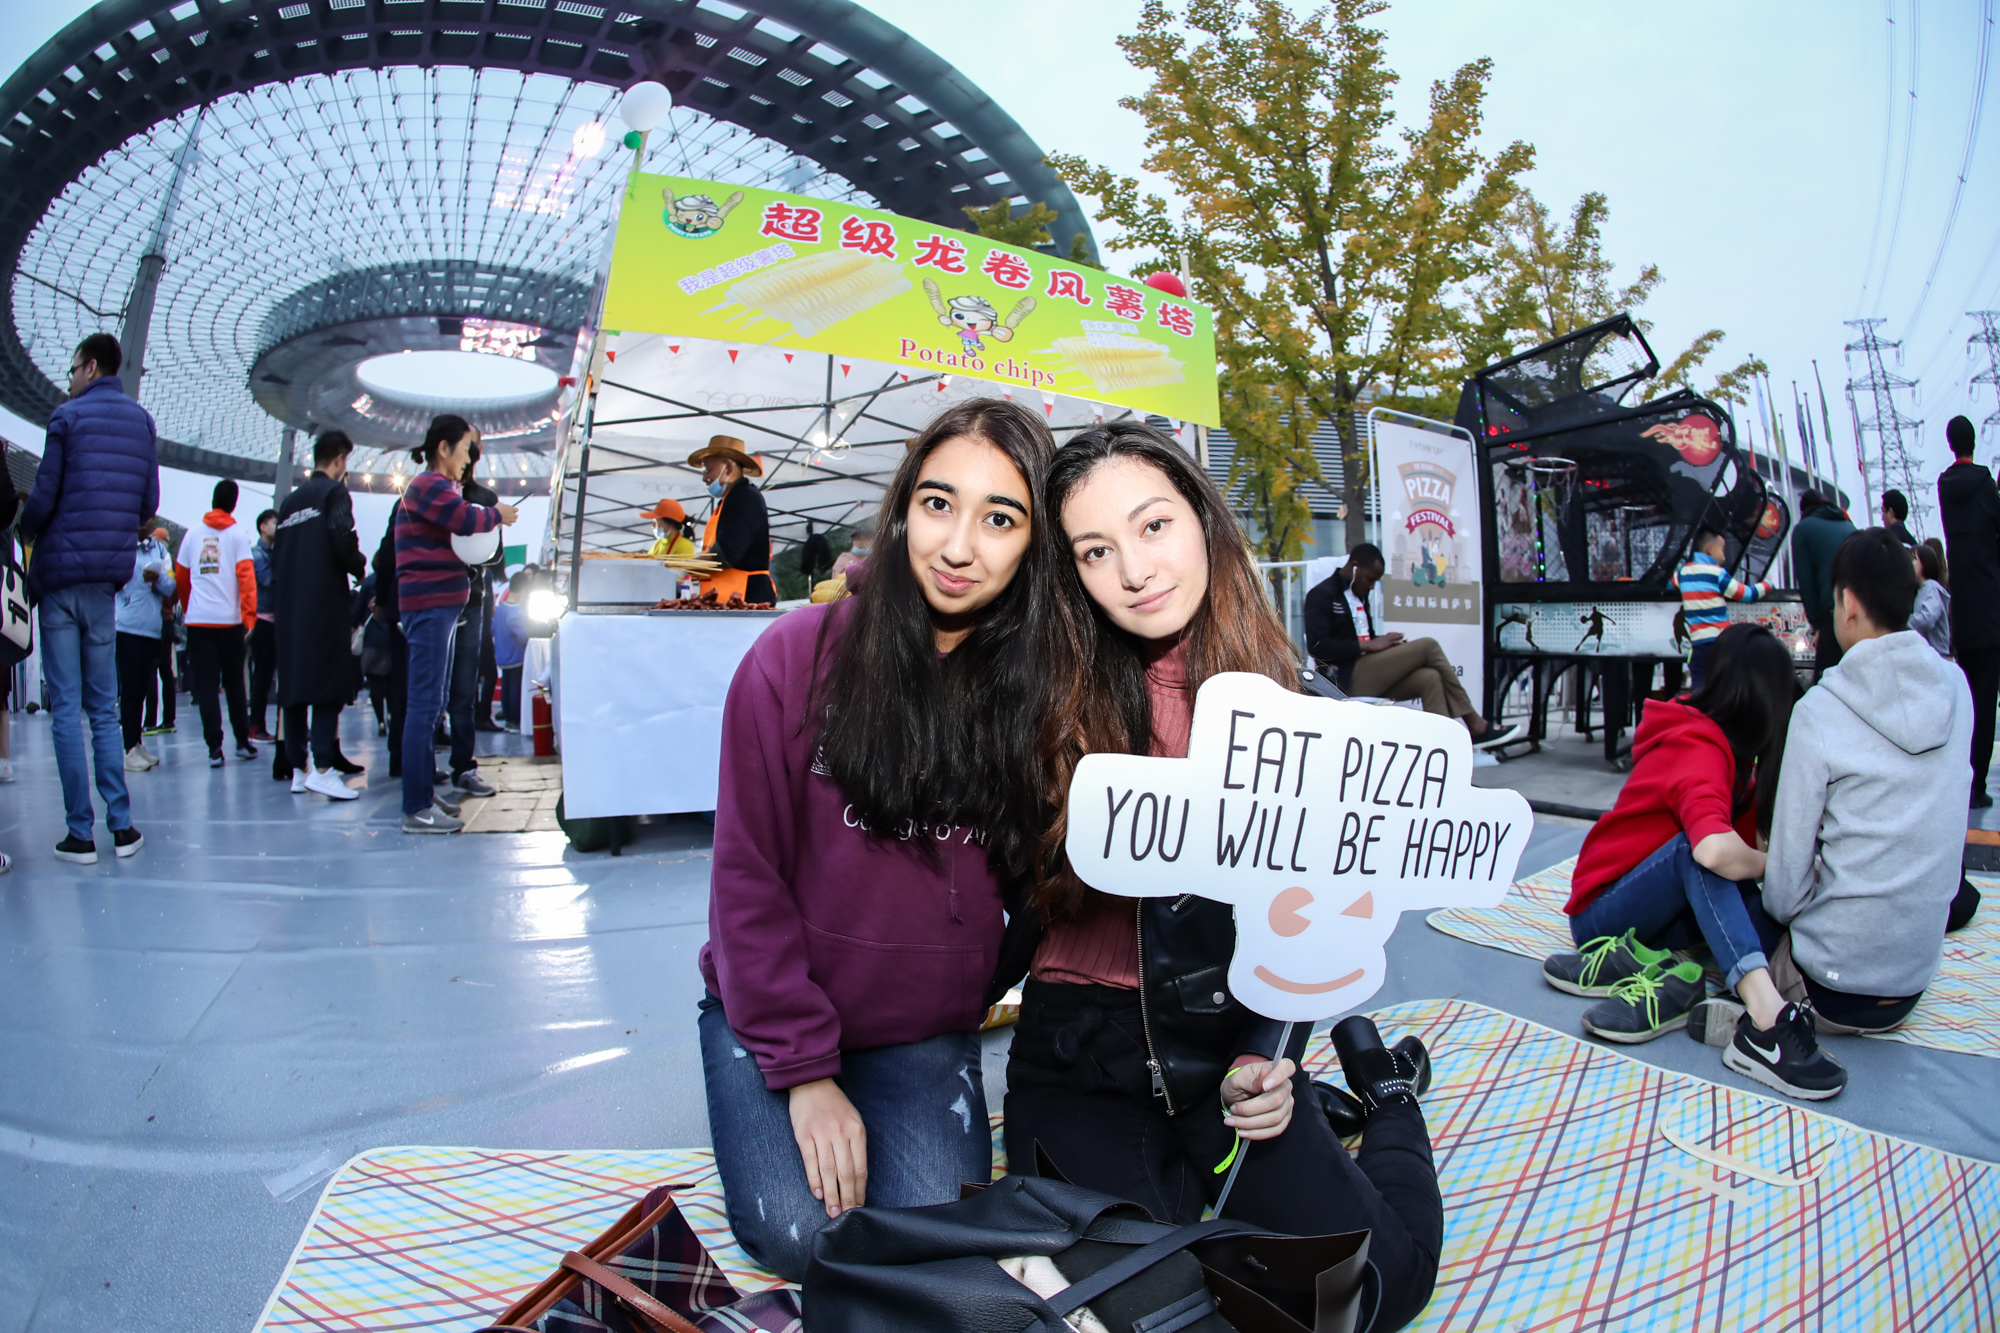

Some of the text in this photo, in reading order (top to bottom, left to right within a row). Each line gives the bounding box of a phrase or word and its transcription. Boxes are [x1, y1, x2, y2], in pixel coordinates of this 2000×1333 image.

[678, 243, 796, 295] 我是超级薯塔
[760, 202, 1195, 336] 超级龙卷风薯塔
[899, 338, 985, 371] Potato
[994, 358, 1055, 387] chips
[1405, 477, 1451, 505] PIZZA
[1410, 511, 1451, 531] FESTIVAL
[1223, 709, 1449, 809] EAT PIZZA
[1103, 786, 1512, 881] YOU WILL BE HAPPY
